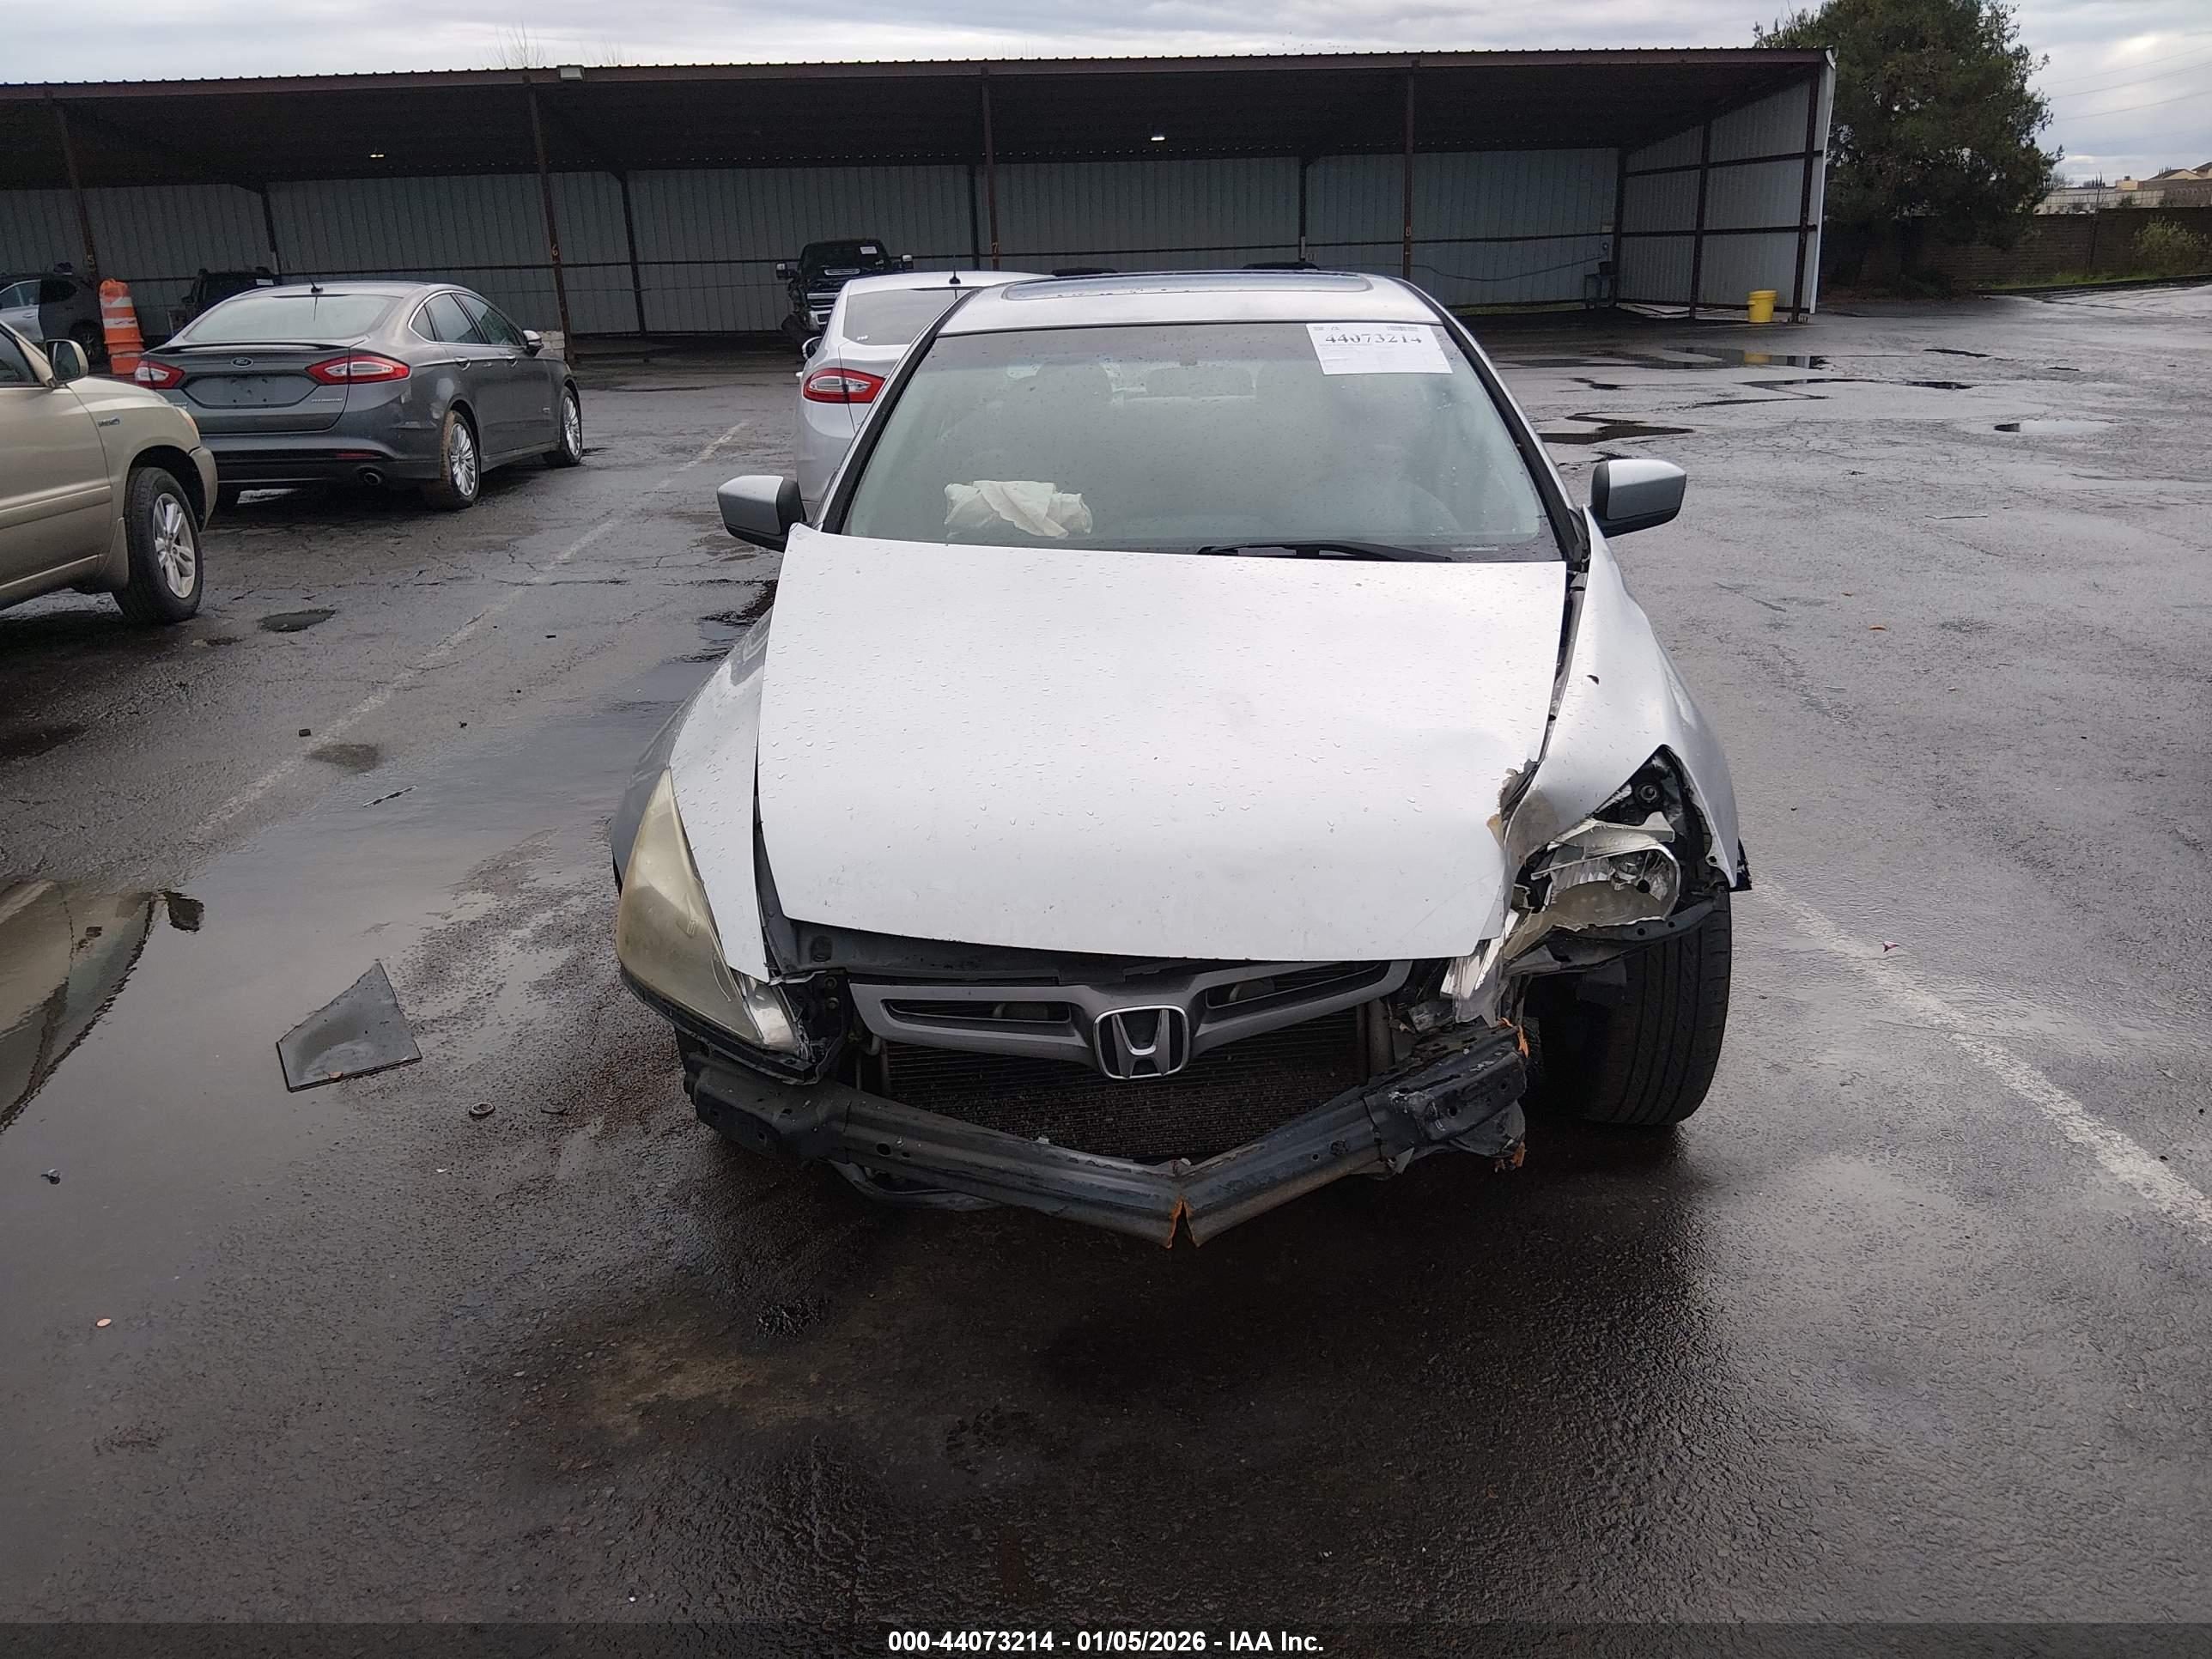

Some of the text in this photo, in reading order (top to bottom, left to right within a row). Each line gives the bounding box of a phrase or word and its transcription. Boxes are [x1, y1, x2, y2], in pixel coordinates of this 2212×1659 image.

[1405, 226, 1412, 237] 8
[552, 244, 558, 256] 6
[992, 242, 998, 253] 7
[1325, 333, 1422, 343] 44073214
